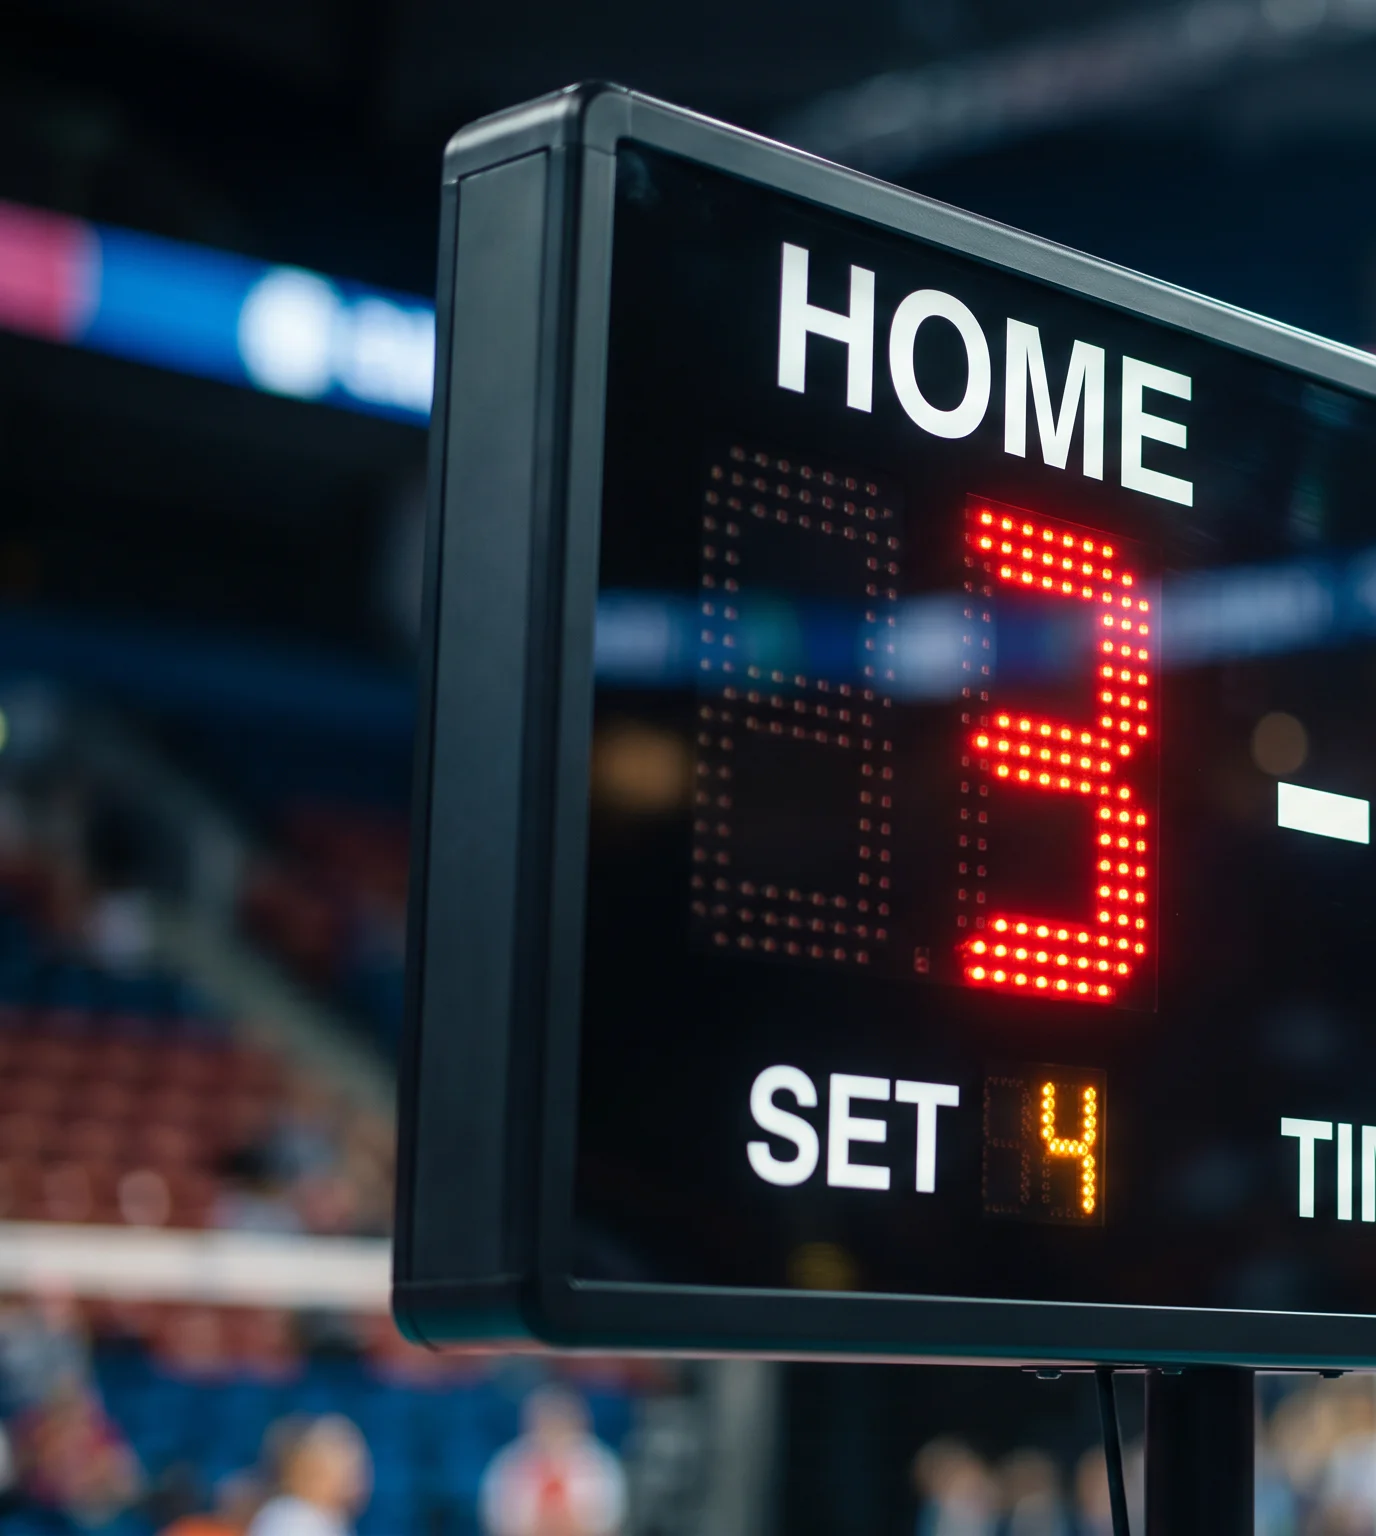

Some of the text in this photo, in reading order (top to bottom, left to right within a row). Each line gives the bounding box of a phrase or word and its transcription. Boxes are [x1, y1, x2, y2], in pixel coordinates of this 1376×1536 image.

[777, 242, 1195, 507] HOME
[960, 505, 1152, 1004] 3
[746, 1065, 1099, 1215] SET 4
